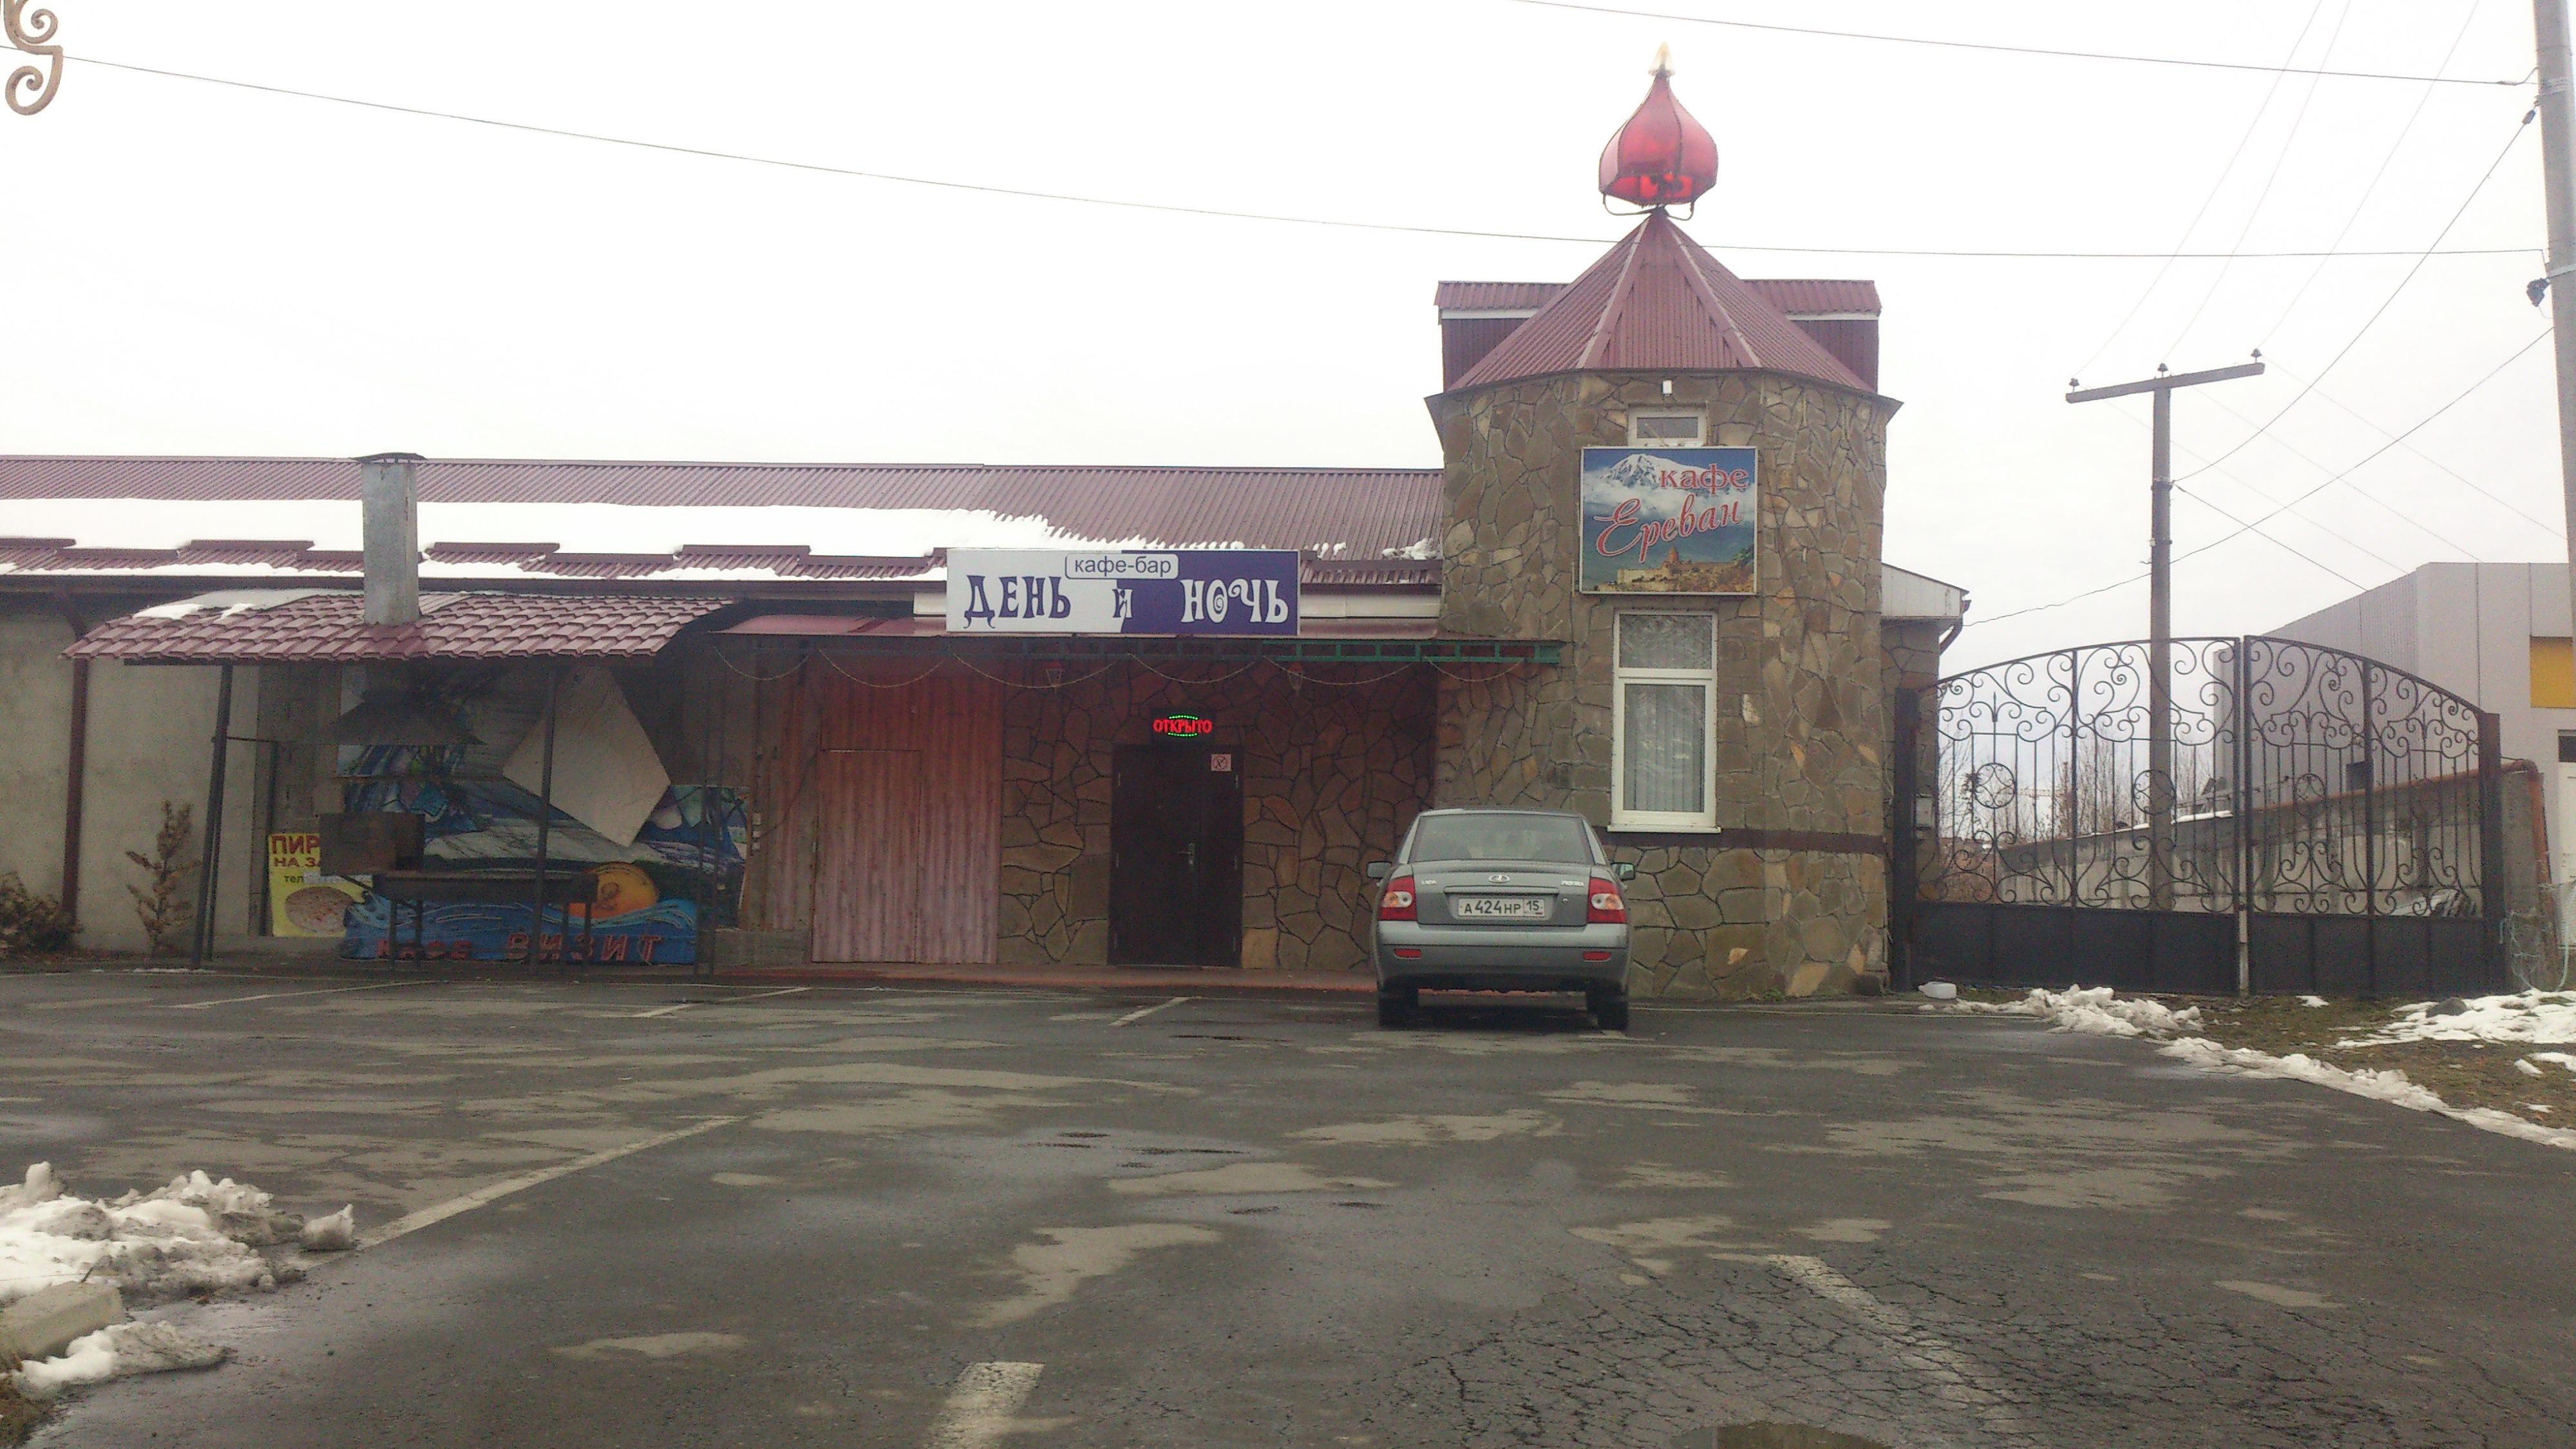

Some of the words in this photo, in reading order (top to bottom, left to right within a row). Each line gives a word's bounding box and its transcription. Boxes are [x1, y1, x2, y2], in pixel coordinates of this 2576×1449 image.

[1660, 463, 1748, 496] кафе
[1593, 493, 1741, 564] Ереван
[1074, 554, 1172, 578] кафе-бар
[963, 575, 1072, 629] ДЕНЬ
[1180, 578, 1289, 623] НОЧЬ
[1153, 719, 1213, 734] ОТКРЫТО
[274, 857, 299, 867] НА
